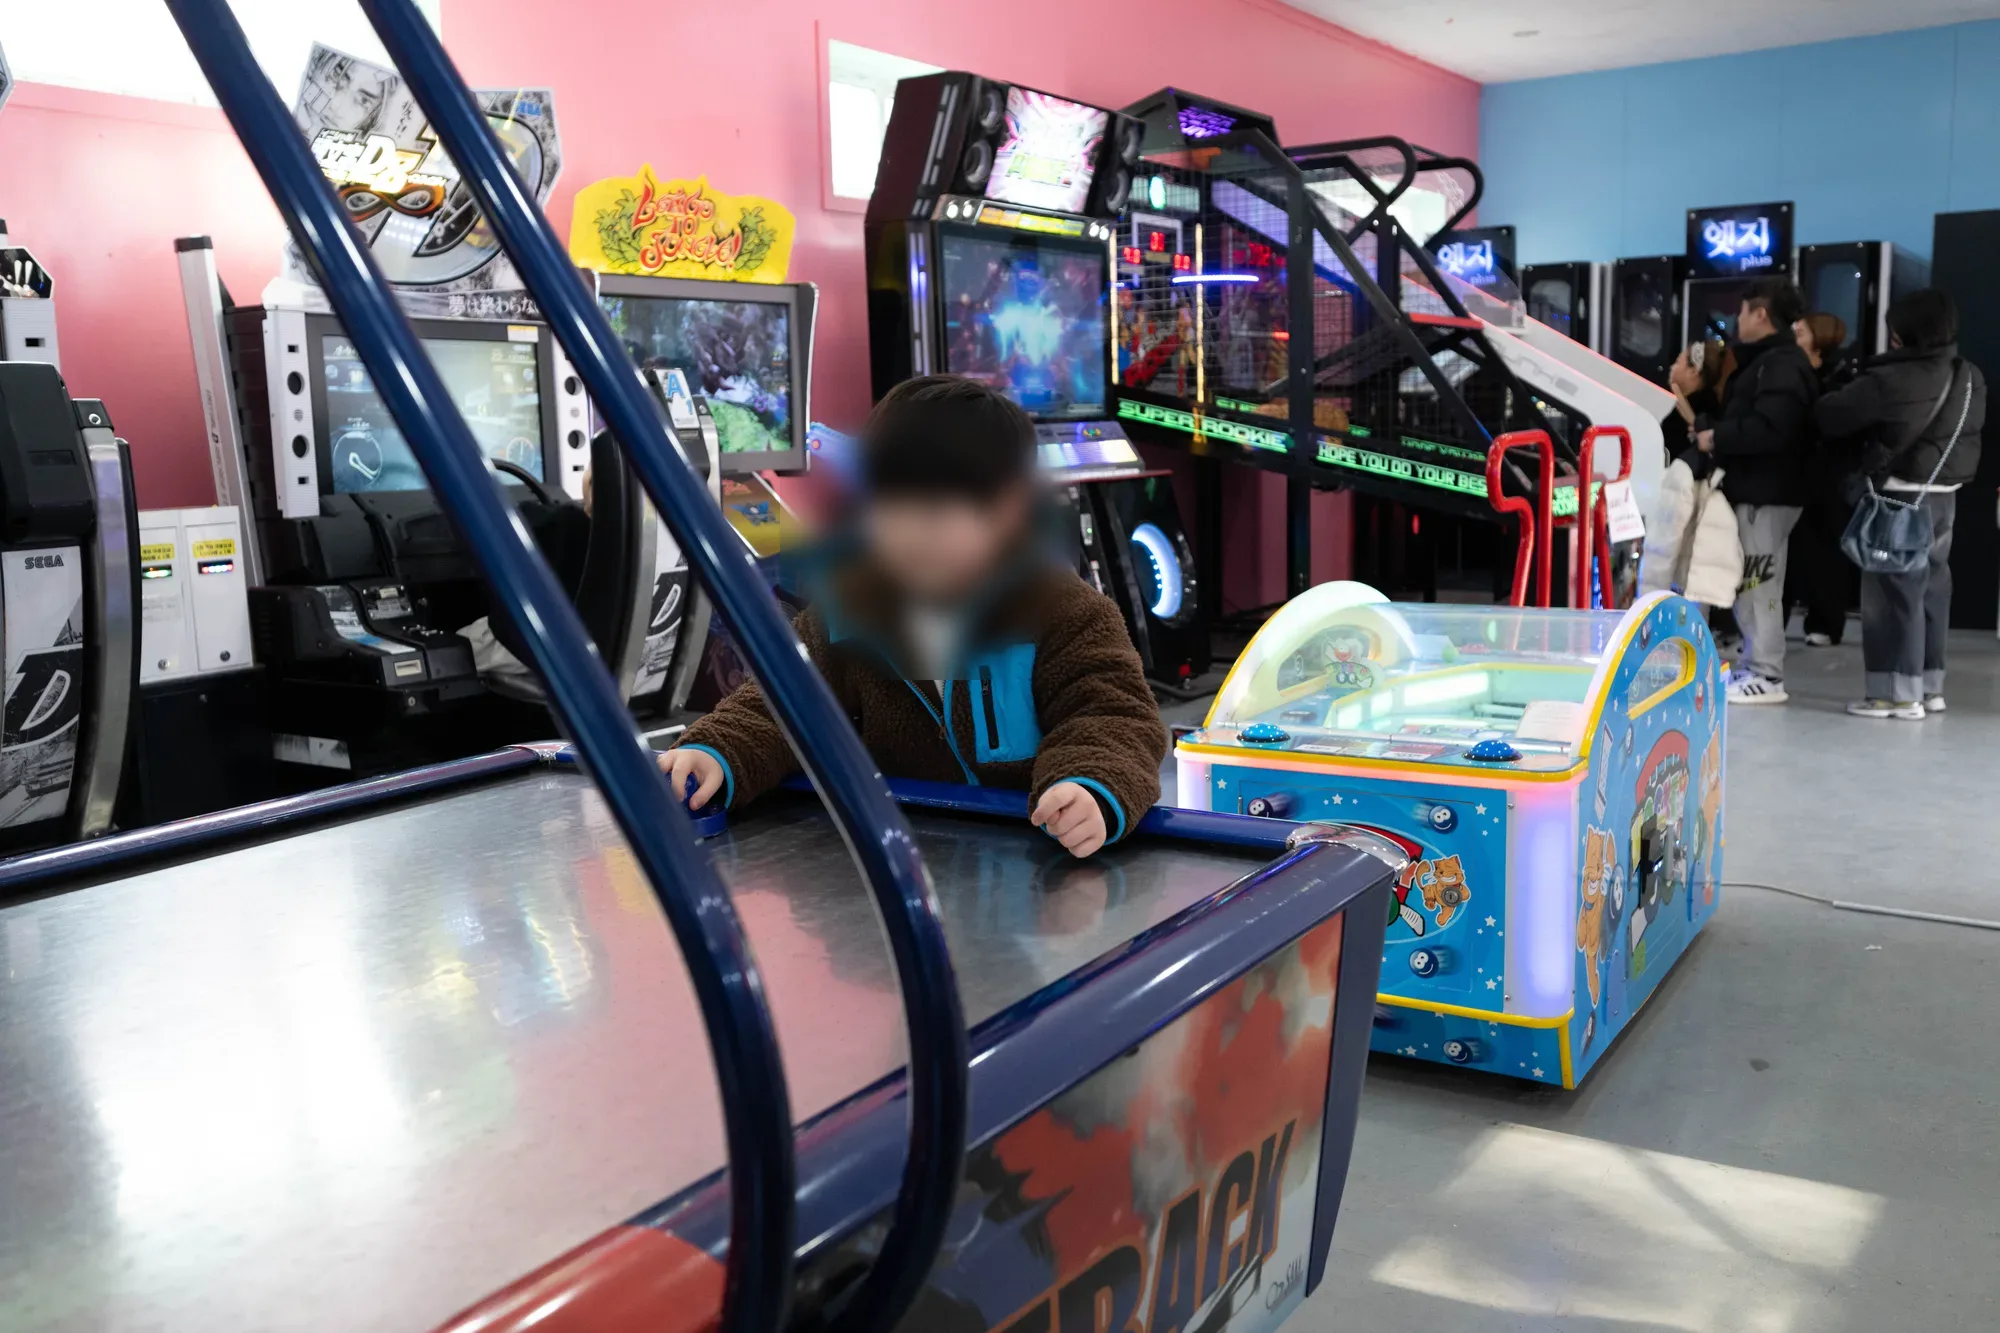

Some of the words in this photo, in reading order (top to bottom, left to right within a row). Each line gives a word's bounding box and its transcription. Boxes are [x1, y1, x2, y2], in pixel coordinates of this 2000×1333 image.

[1740, 254, 1774, 271] plus
[1119, 400, 1195, 428] SUPER
[1202, 421, 1286, 449] ROOKIE
[1318, 443, 1357, 460] HOPE
[1359, 452, 1390, 471] YOU
[1391, 461, 1412, 476] DO
[1415, 465, 1455, 486] YOUR
[1458, 475, 1488, 492] BES
[25, 555, 64, 569] SEGA
[988, 1117, 1298, 1333] RACK
